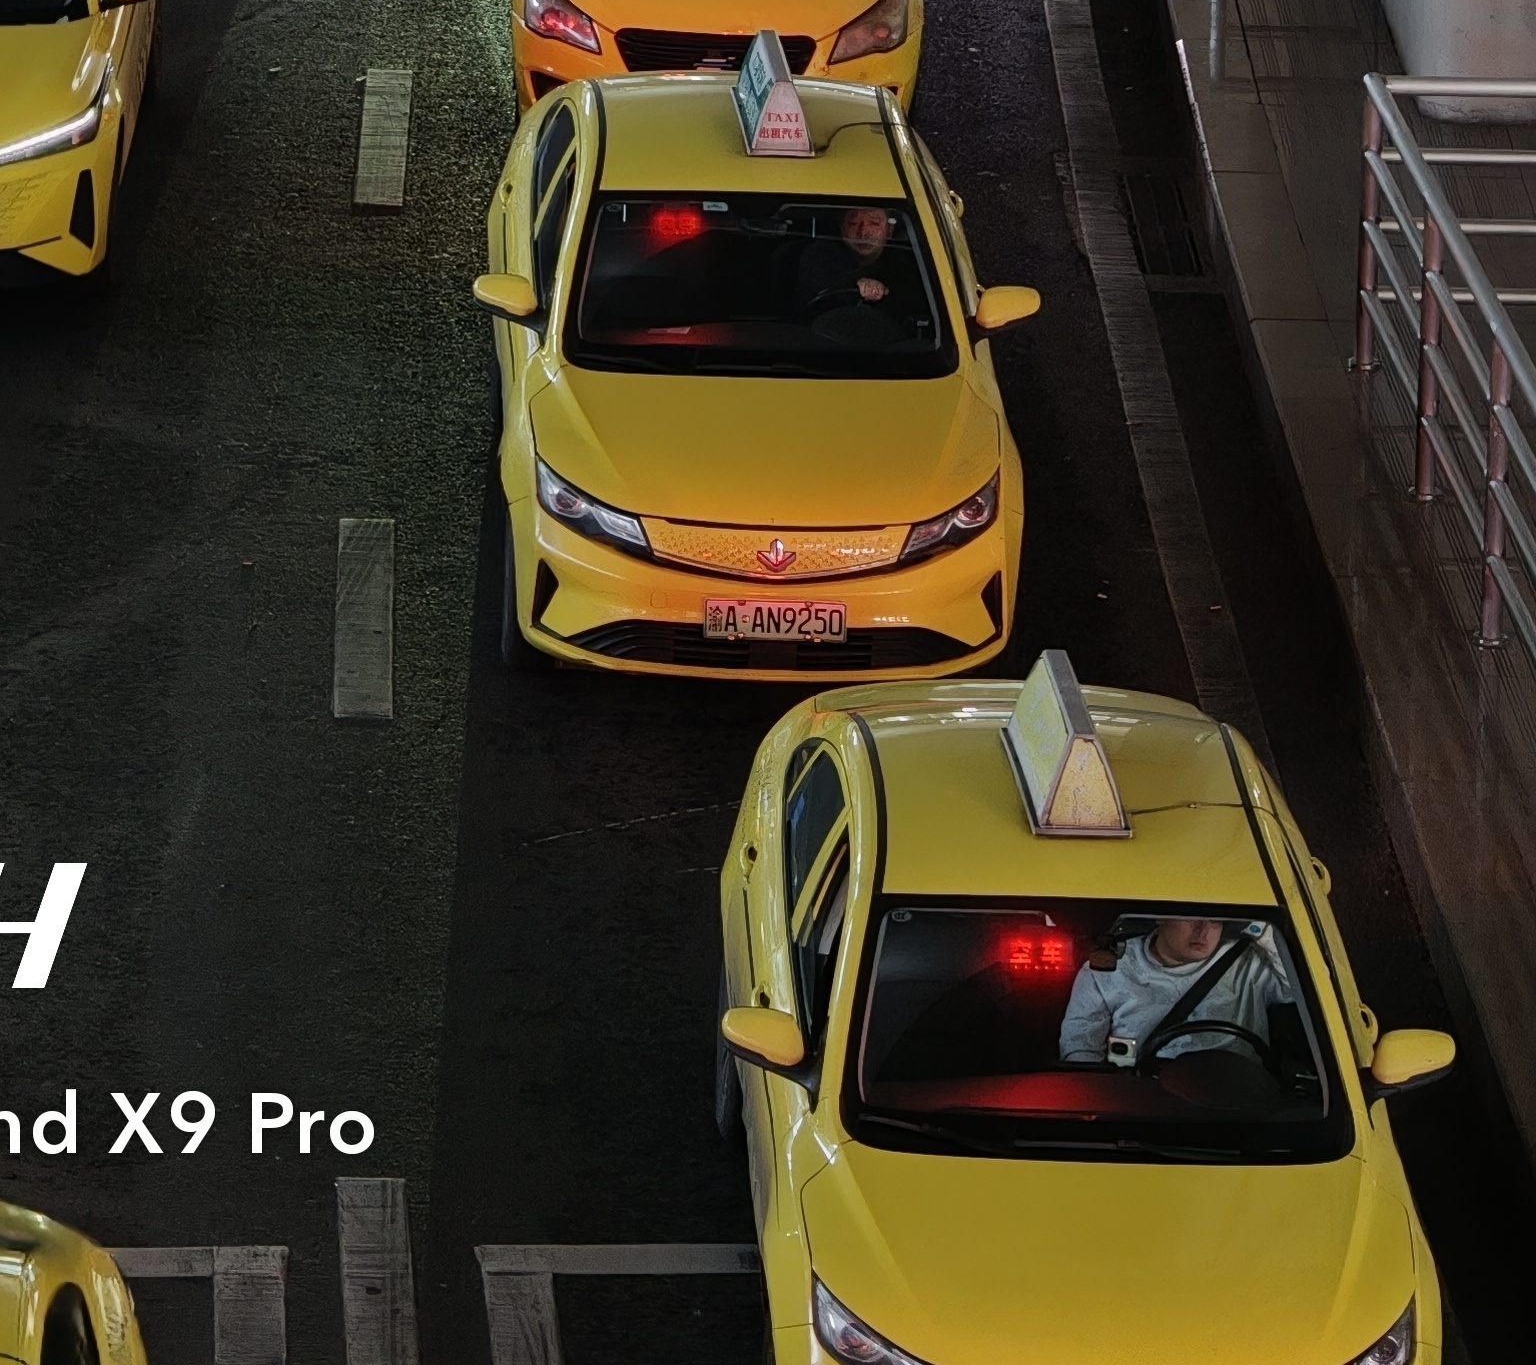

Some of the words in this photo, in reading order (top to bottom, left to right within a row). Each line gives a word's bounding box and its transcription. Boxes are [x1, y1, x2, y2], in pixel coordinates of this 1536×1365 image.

[766, 113, 800, 122] TAXI
[758, 127, 804, 139] 出租汽车
[1010, 939, 1063, 964] 空车
